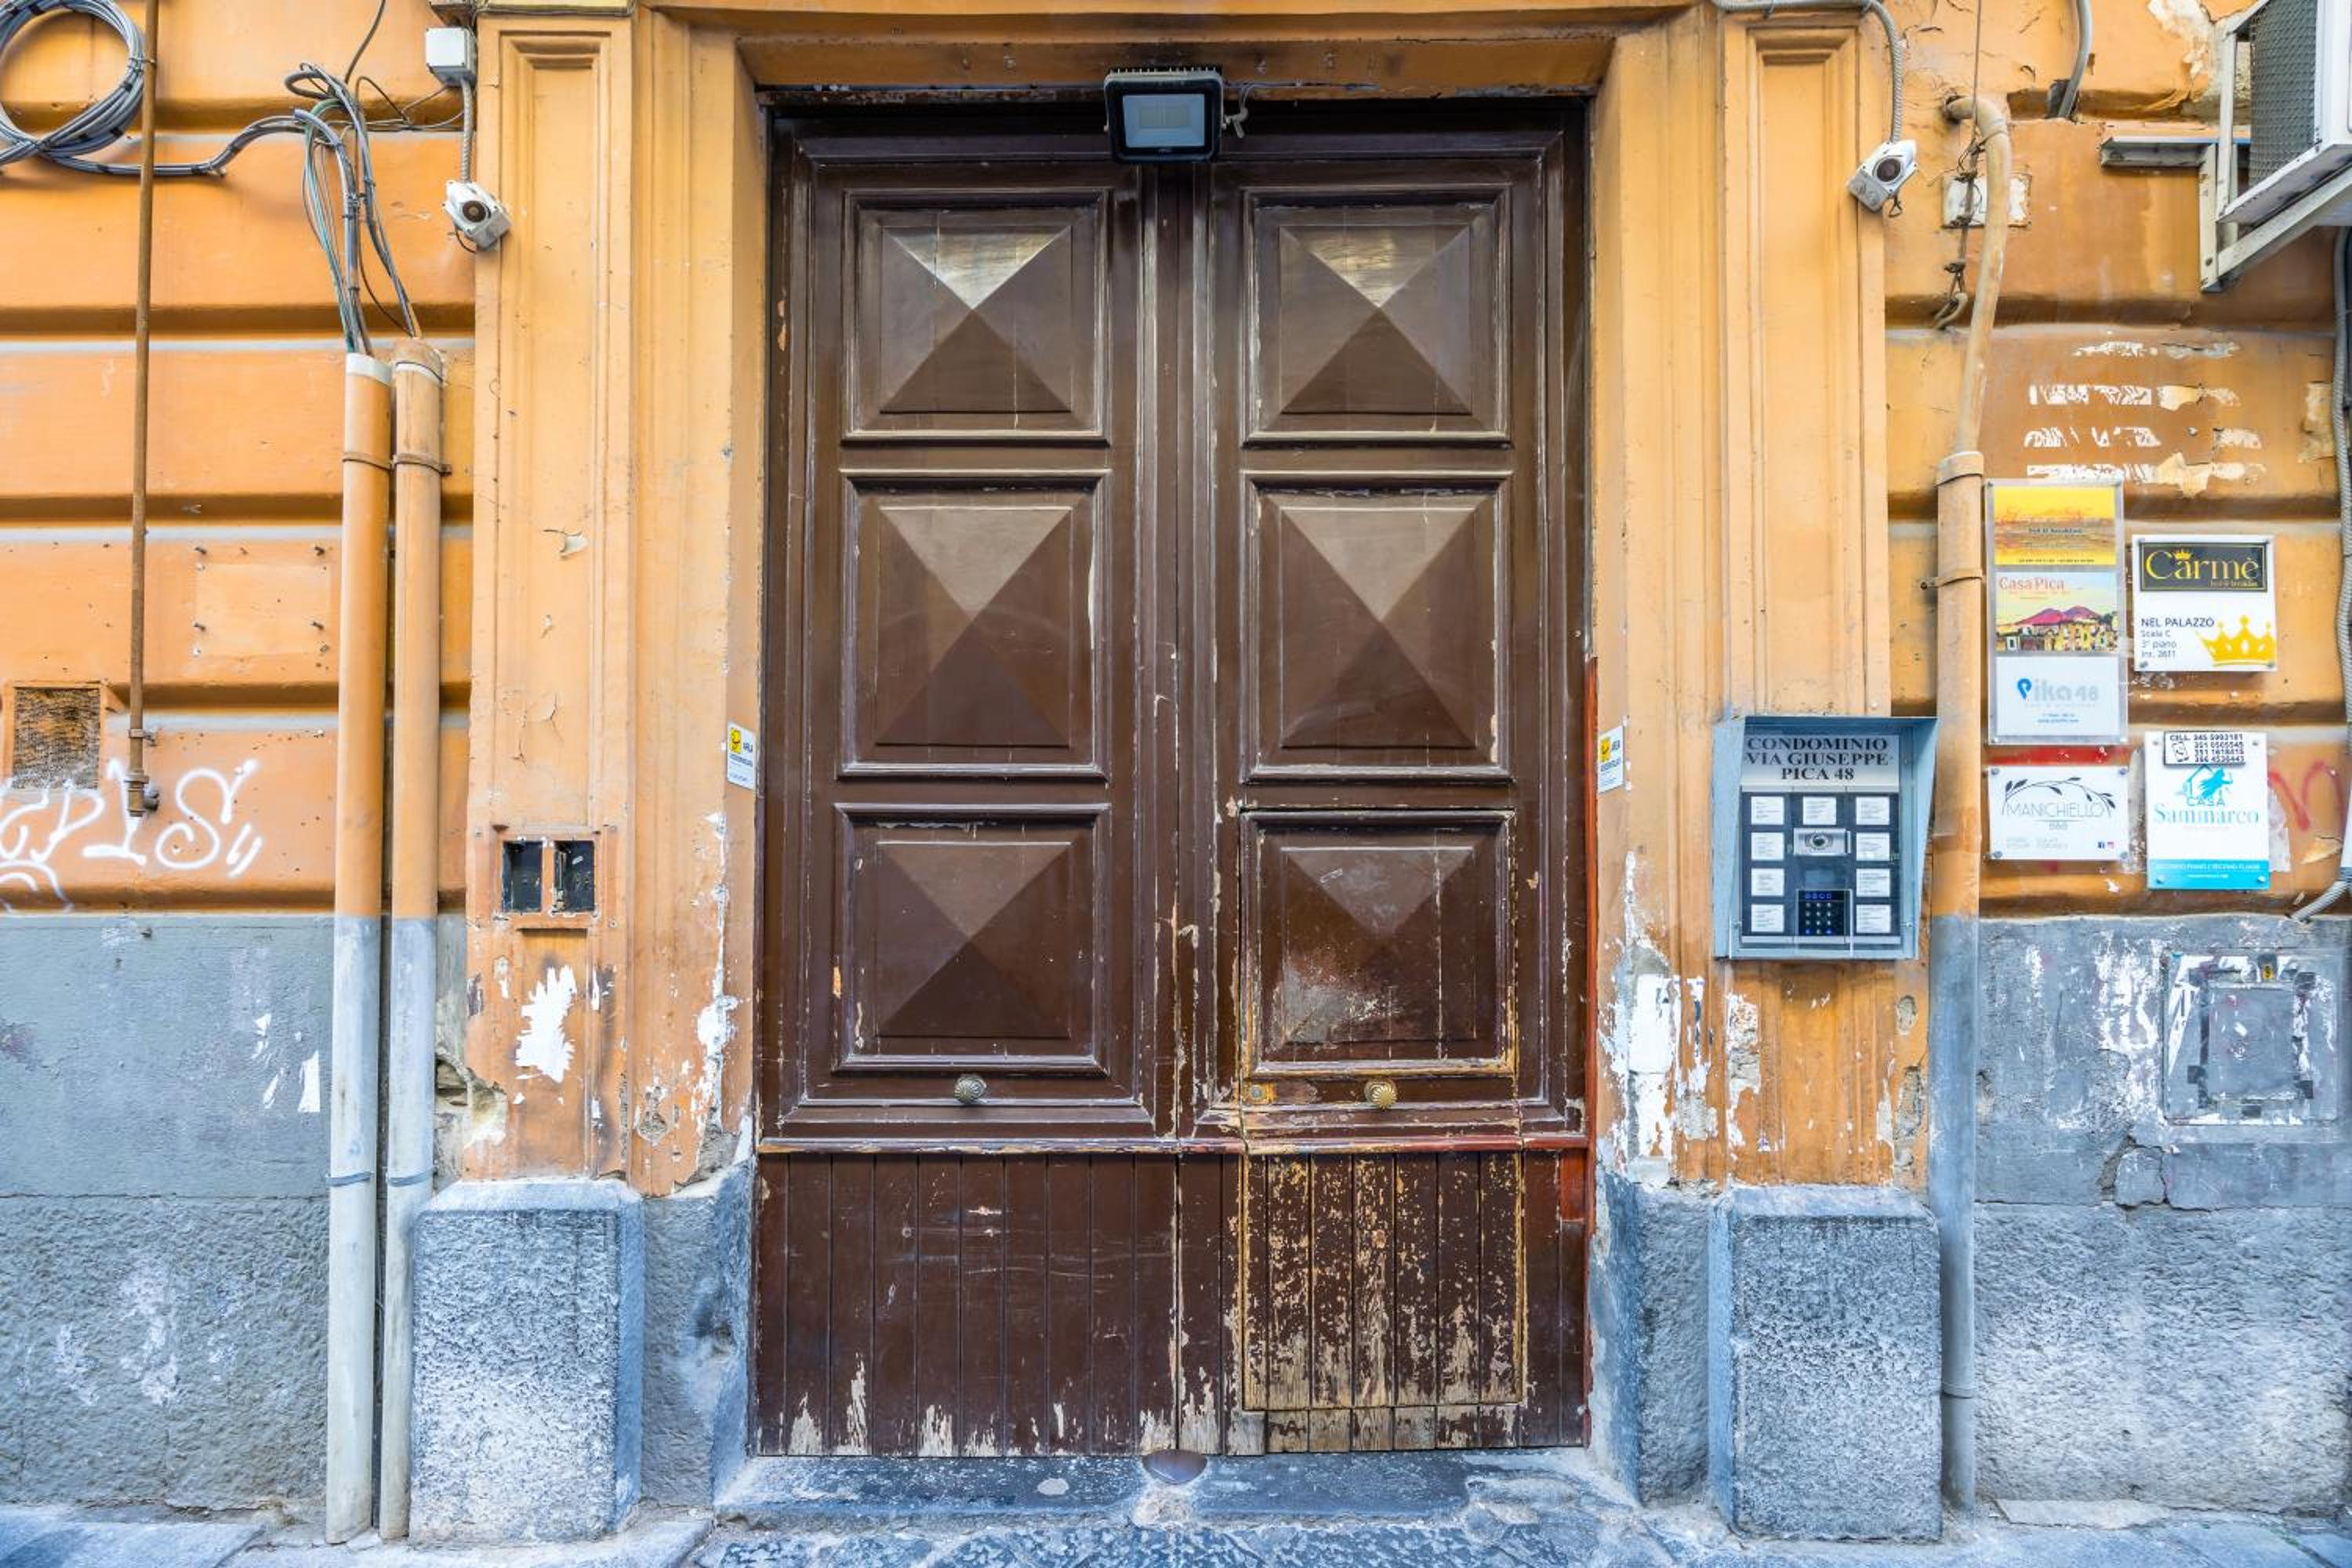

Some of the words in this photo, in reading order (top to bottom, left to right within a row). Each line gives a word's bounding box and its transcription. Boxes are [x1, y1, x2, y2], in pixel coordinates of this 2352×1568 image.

[2145, 550, 2259, 580] Carmè
[2141, 617, 2161, 627] NEL
[2165, 617, 2215, 627] PALAZZO
[1747, 737, 1888, 750] CONDOMINIO
[1744, 752, 1782, 765] VIA
[1787, 752, 1889, 766] GIUSEPPE
[1780, 768, 1830, 780] PICA
[1834, 768, 1855, 780] 48
[2187, 797, 2226, 807] CASA
[2154, 804, 2259, 824] Sammarco
